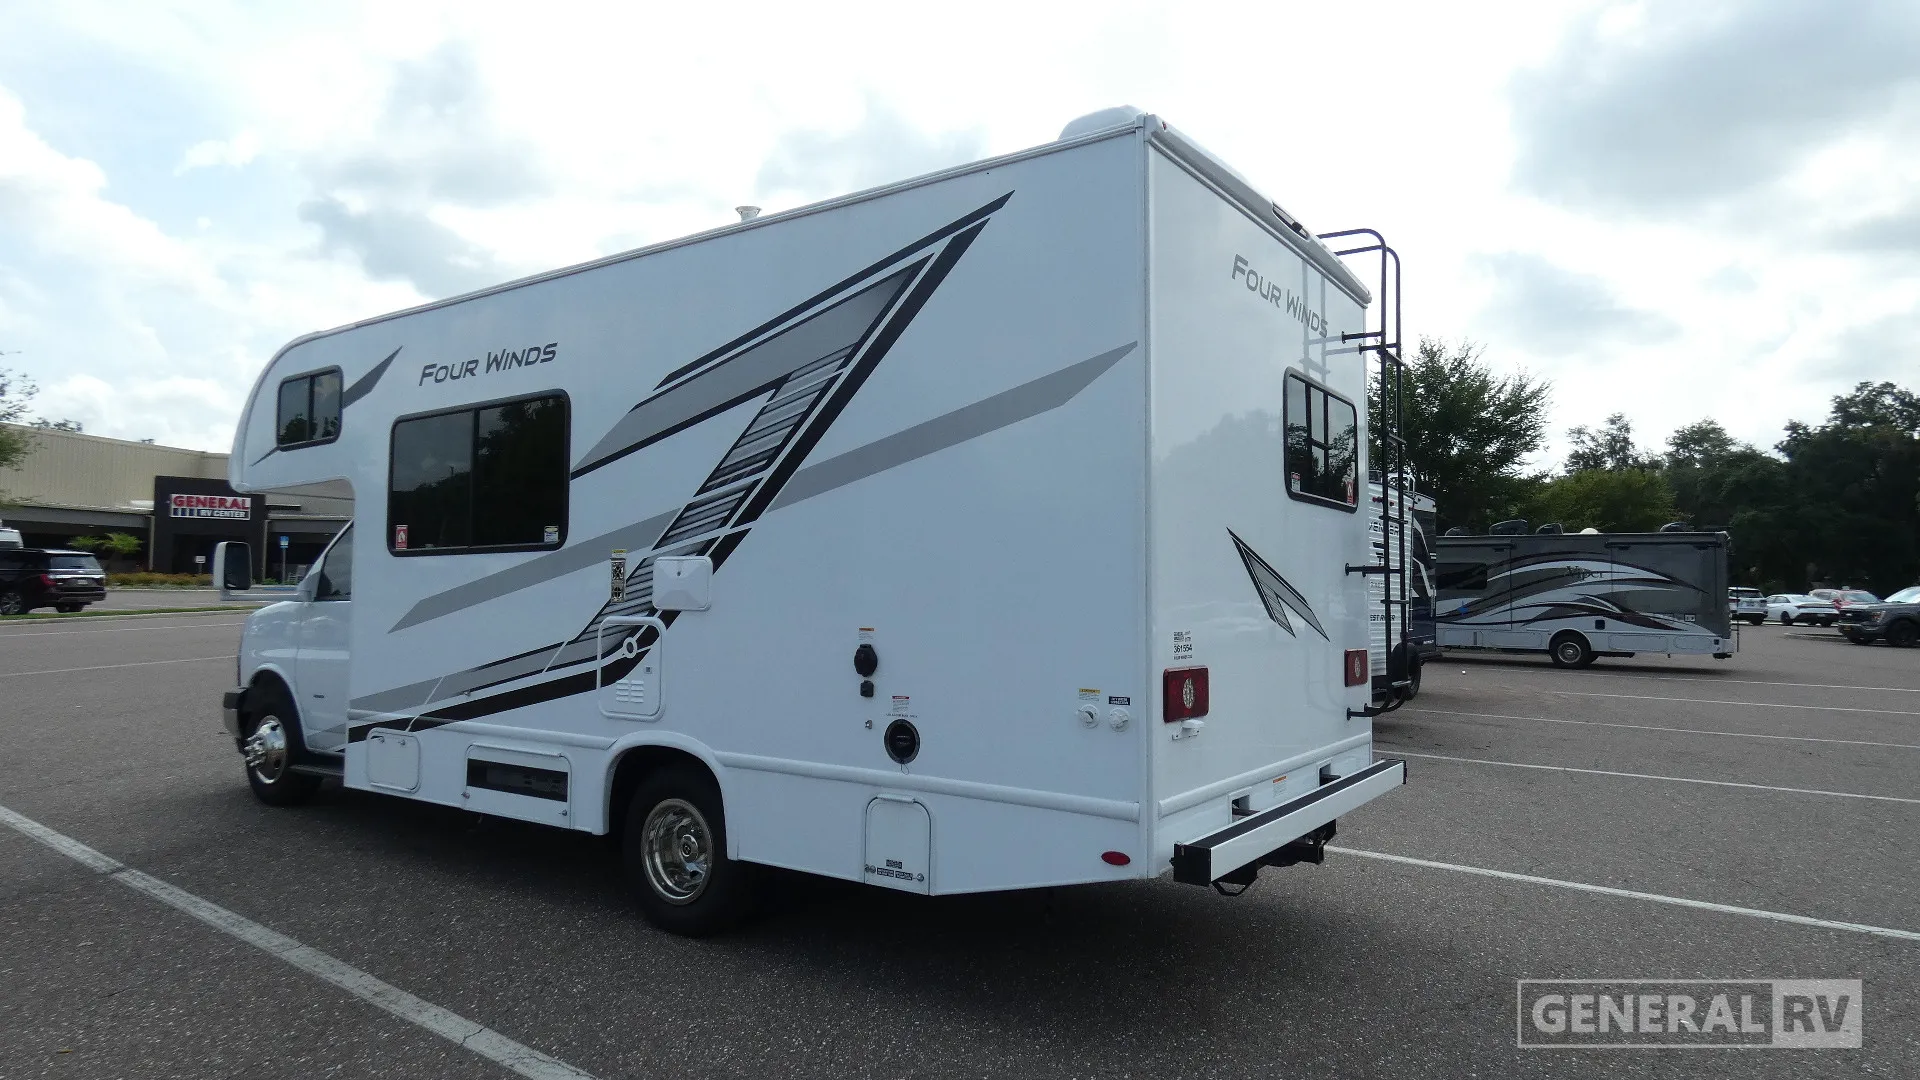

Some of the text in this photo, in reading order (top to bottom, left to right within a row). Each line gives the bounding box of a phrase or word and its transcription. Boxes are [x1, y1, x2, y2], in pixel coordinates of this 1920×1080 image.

[1232, 253, 1328, 339] FOUR WINDS
[419, 342, 559, 387] FOUR WINDS
[173, 495, 249, 510] GENERAL
[200, 509, 246, 518] RV CENTER
